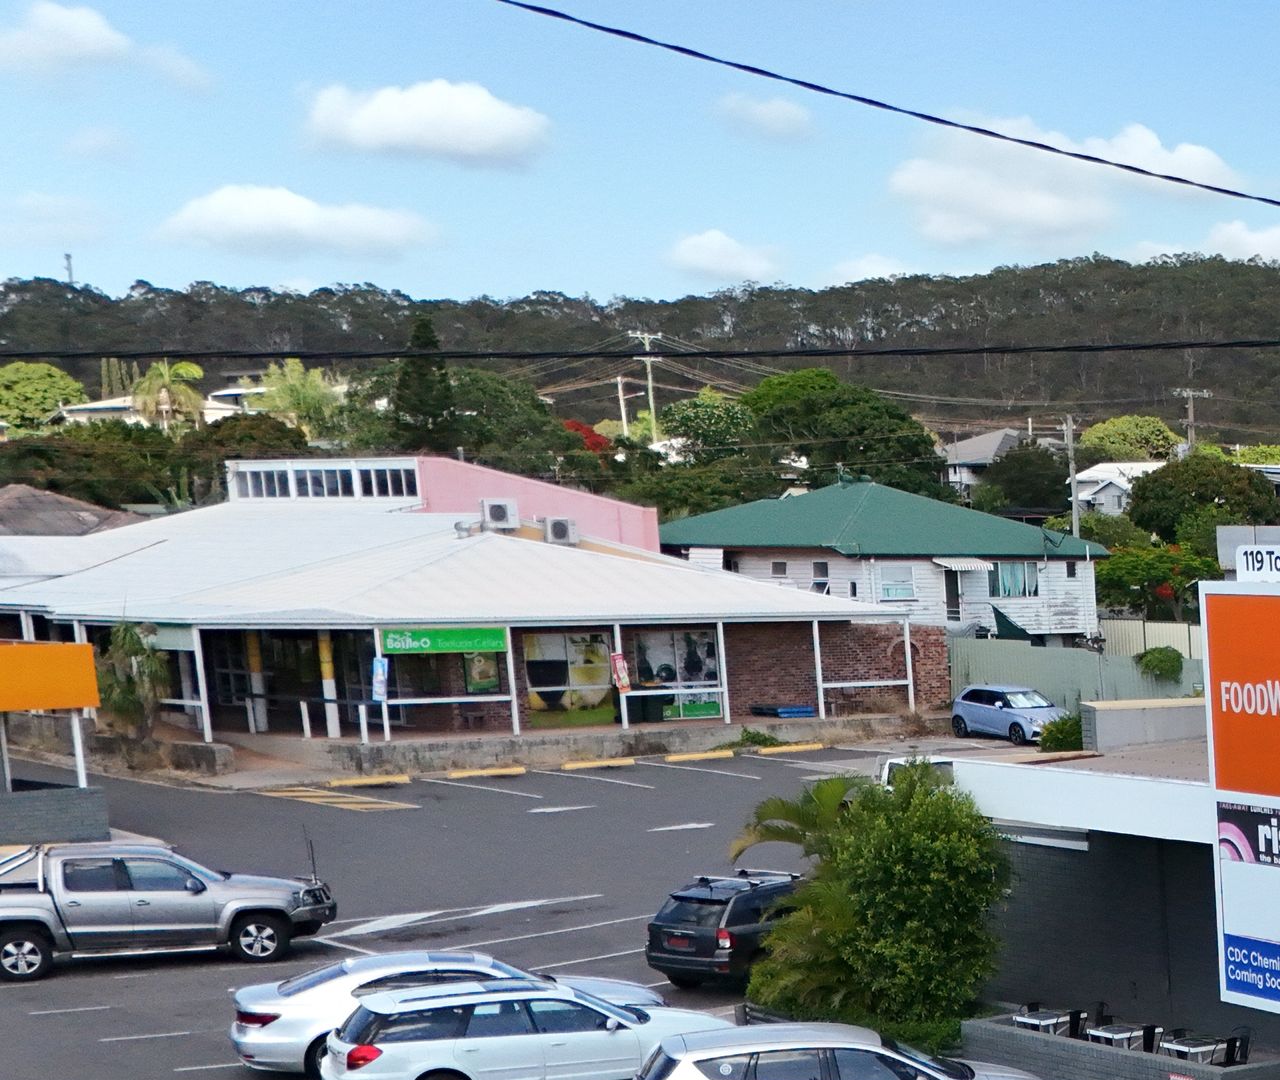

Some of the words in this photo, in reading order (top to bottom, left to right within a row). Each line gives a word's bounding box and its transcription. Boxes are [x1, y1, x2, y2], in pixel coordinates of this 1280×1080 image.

[1243, 551, 1264, 572] 119
[1259, 854, 1272, 863] the
[1228, 947, 1248, 964] CDC
[1228, 965, 1263, 988] Coming
